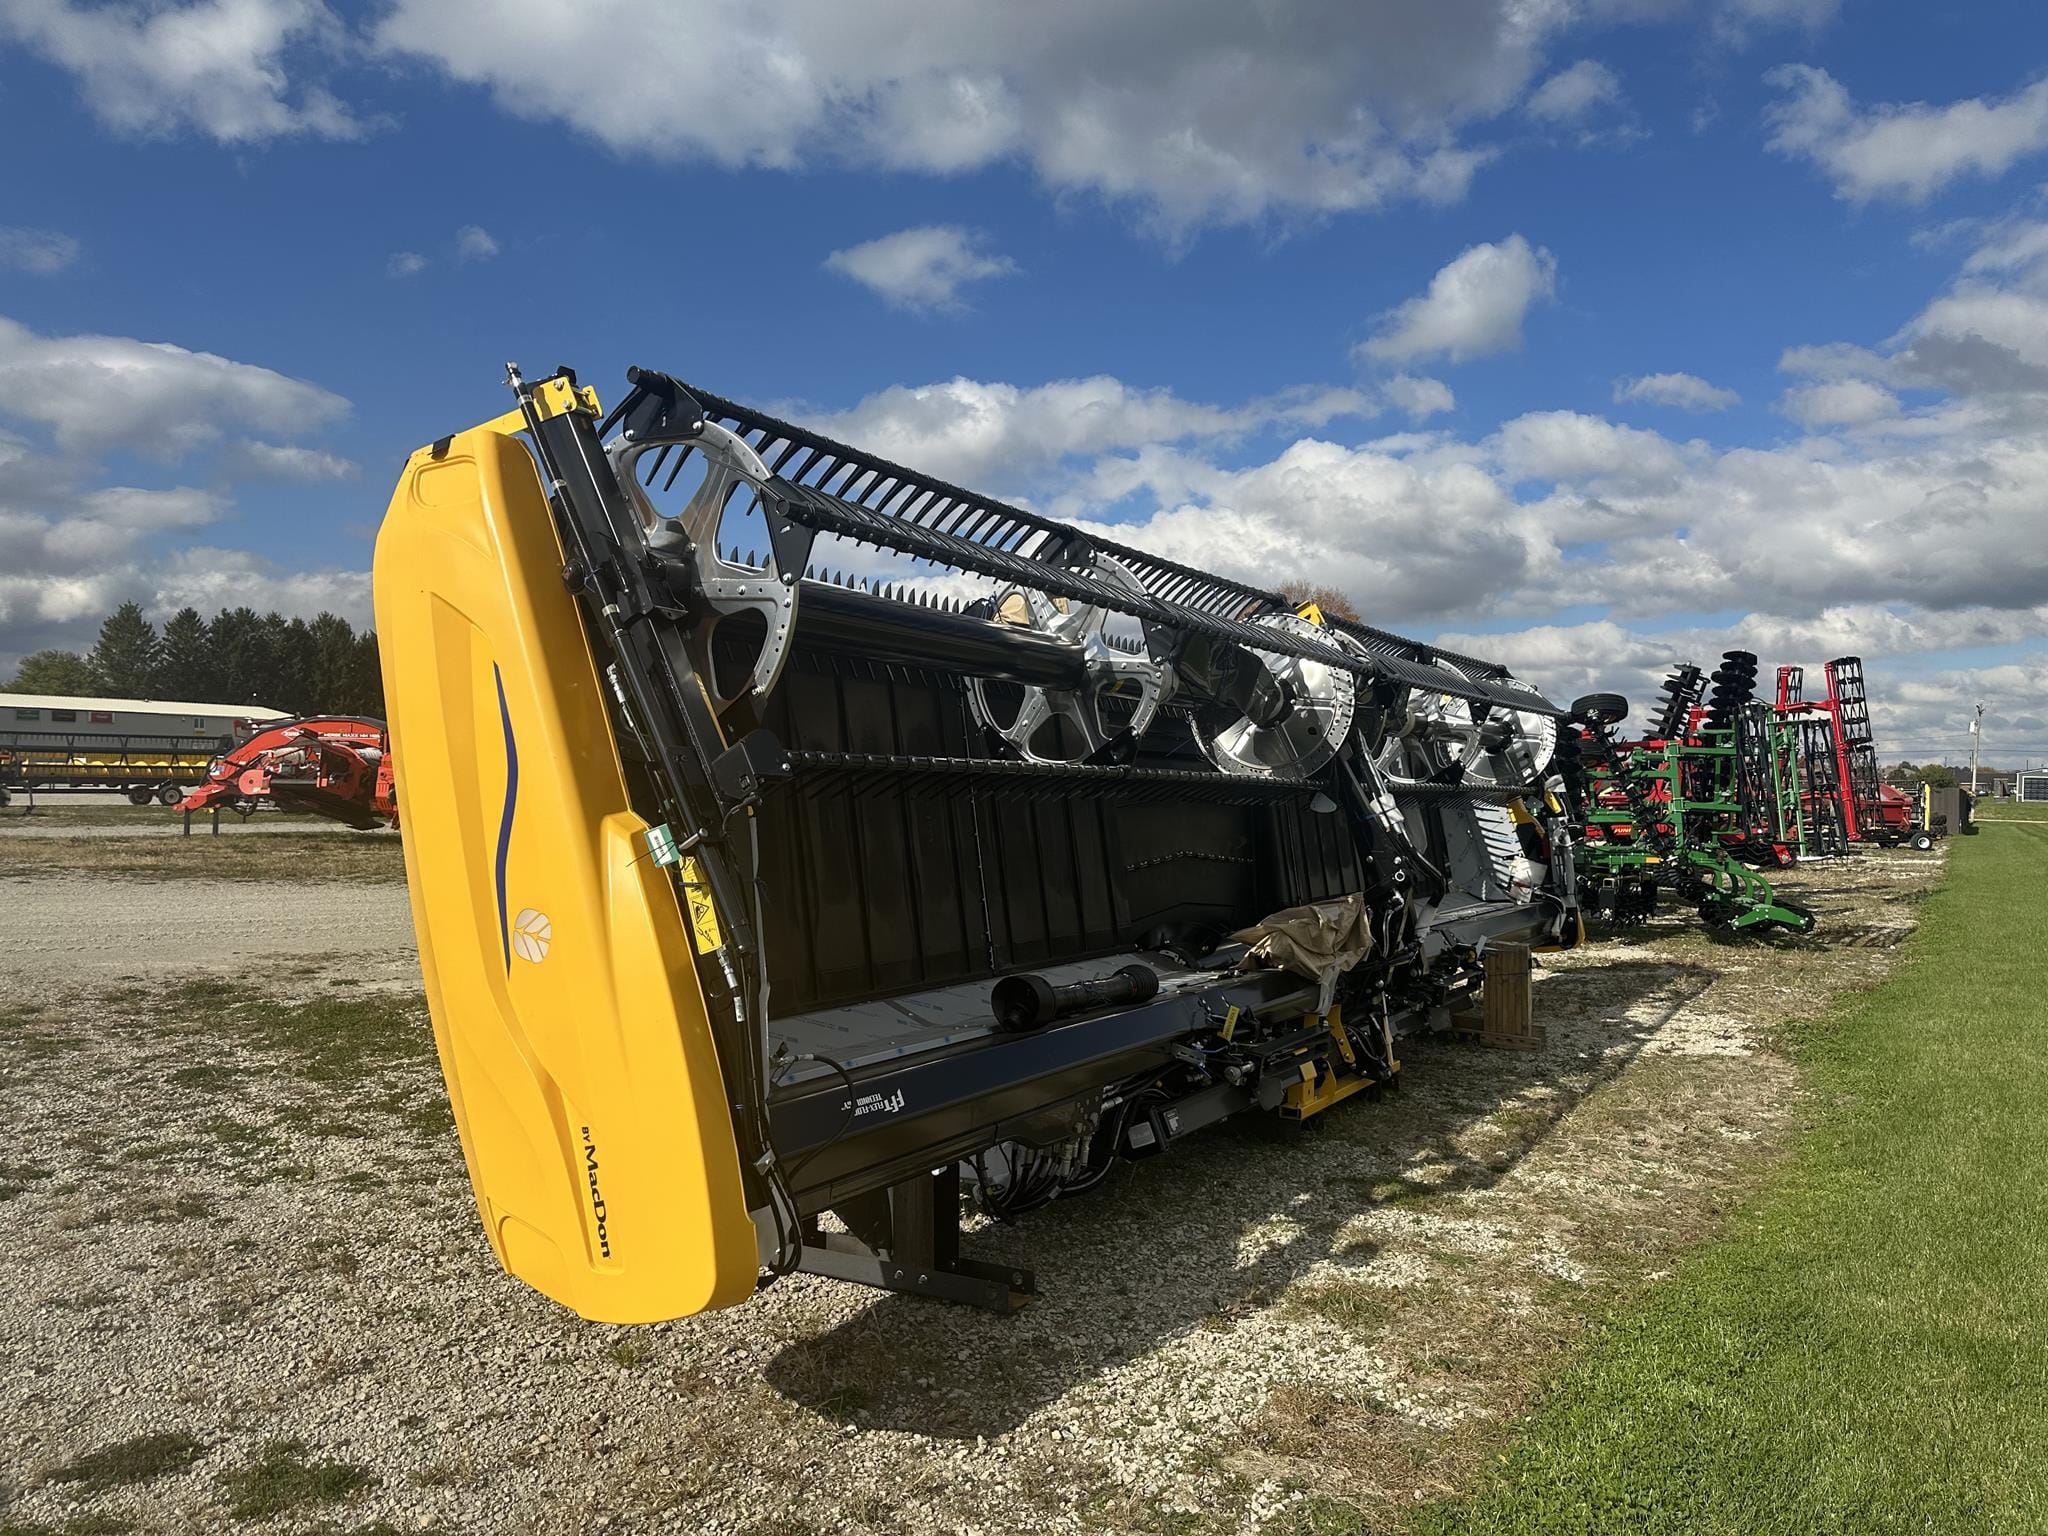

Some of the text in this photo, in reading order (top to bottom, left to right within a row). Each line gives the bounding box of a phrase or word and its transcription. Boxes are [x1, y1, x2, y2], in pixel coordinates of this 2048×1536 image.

[884, 1088, 905, 1113] FFT
[581, 1126, 591, 1143] BY
[584, 1145, 611, 1258] MacDon
